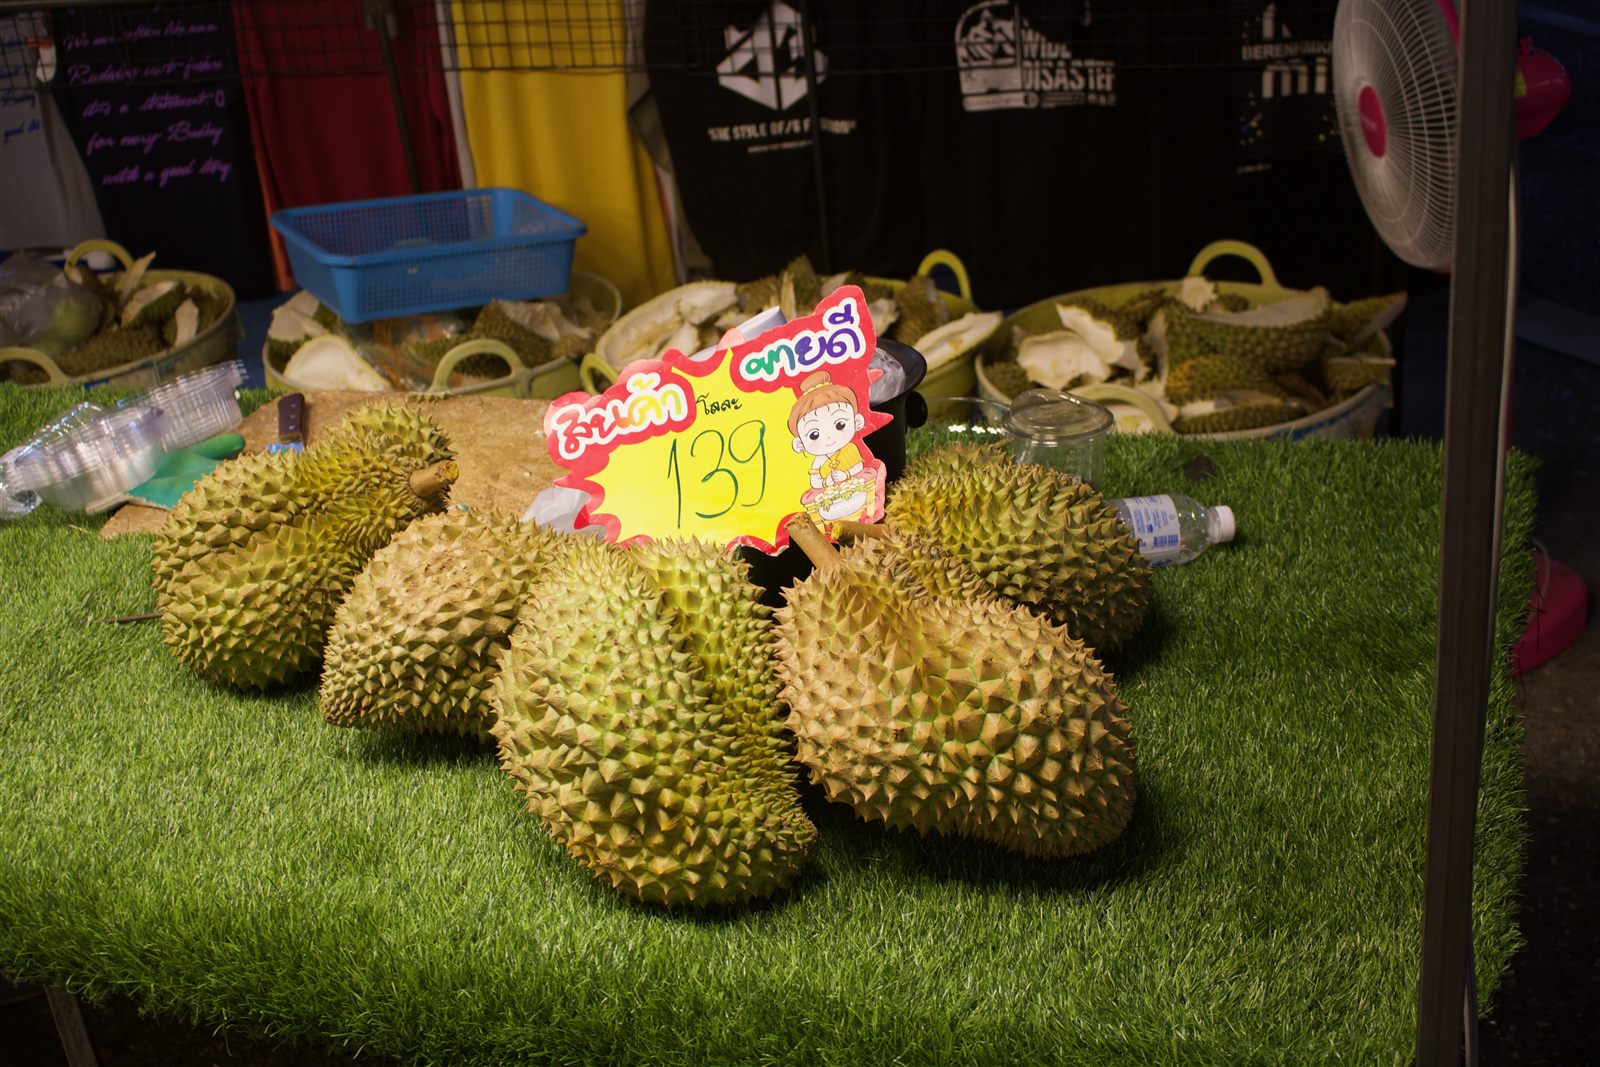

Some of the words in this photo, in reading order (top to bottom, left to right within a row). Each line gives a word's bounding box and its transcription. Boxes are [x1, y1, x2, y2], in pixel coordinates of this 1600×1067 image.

[742, 302, 862, 378] ขายดี
[554, 375, 685, 457] สินค้า
[667, 419, 767, 529] 139
